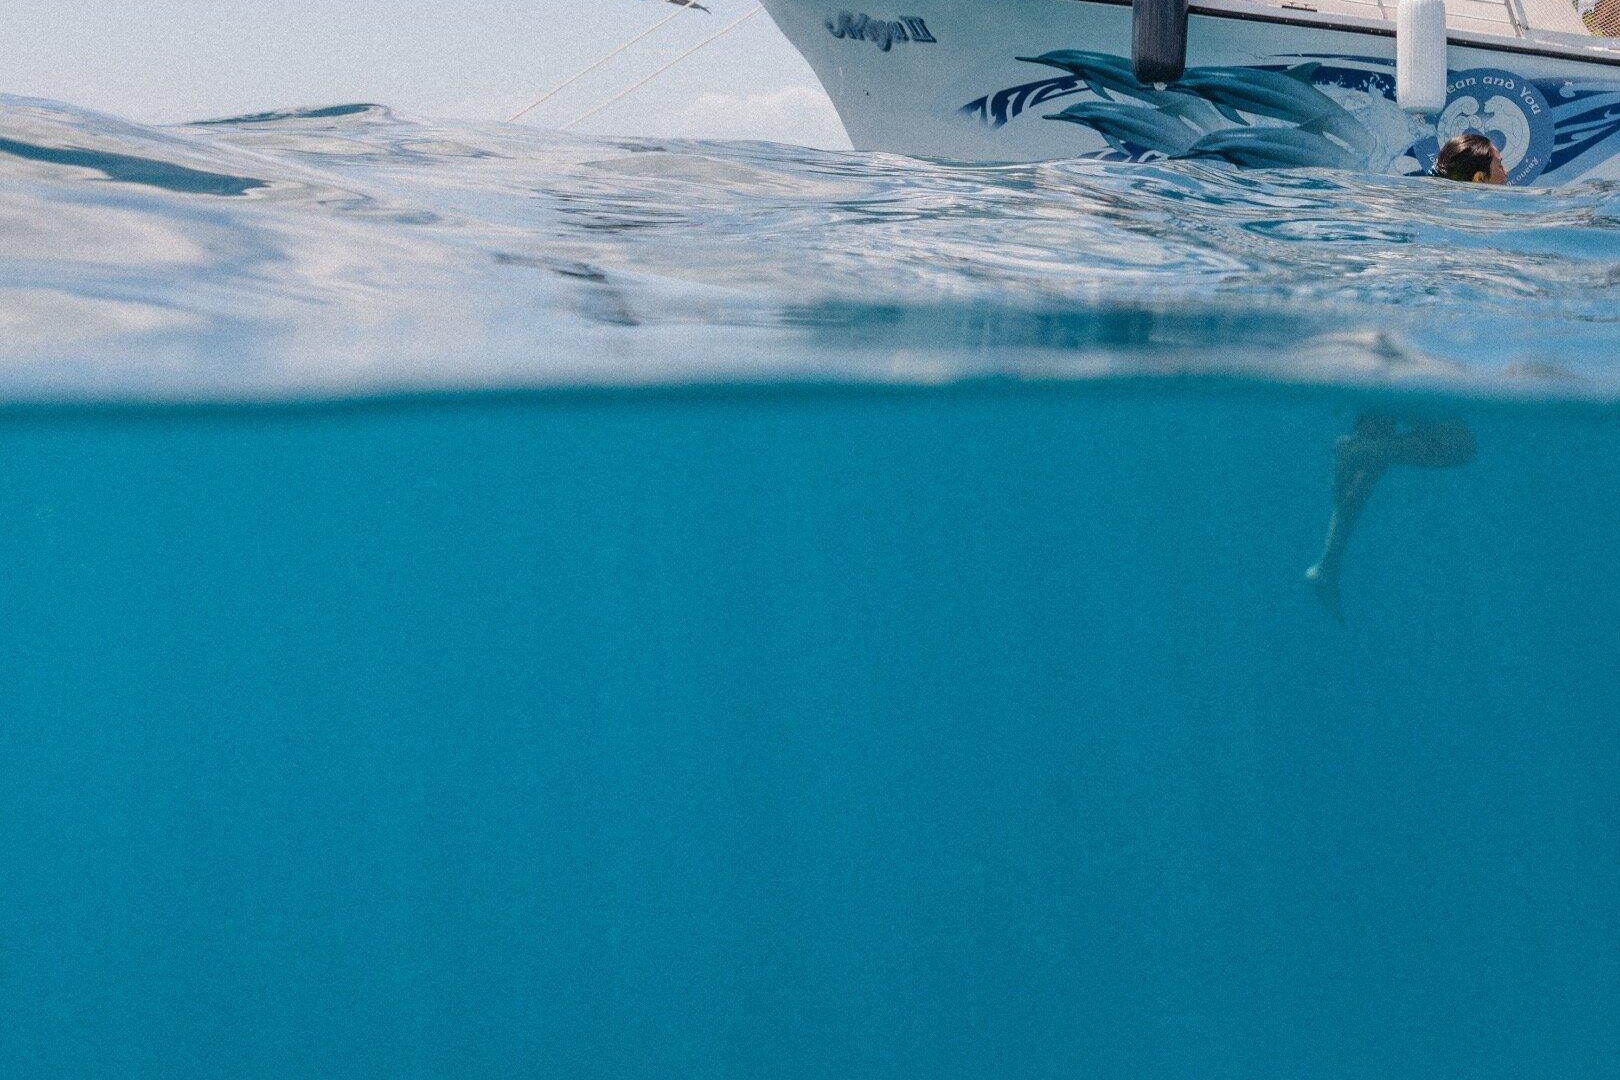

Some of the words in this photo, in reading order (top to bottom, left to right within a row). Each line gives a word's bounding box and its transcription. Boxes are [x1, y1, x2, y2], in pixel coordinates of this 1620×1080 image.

[1446, 77, 1476, 94] ean
[1483, 76, 1515, 90] and
[1520, 86, 1541, 115] You
